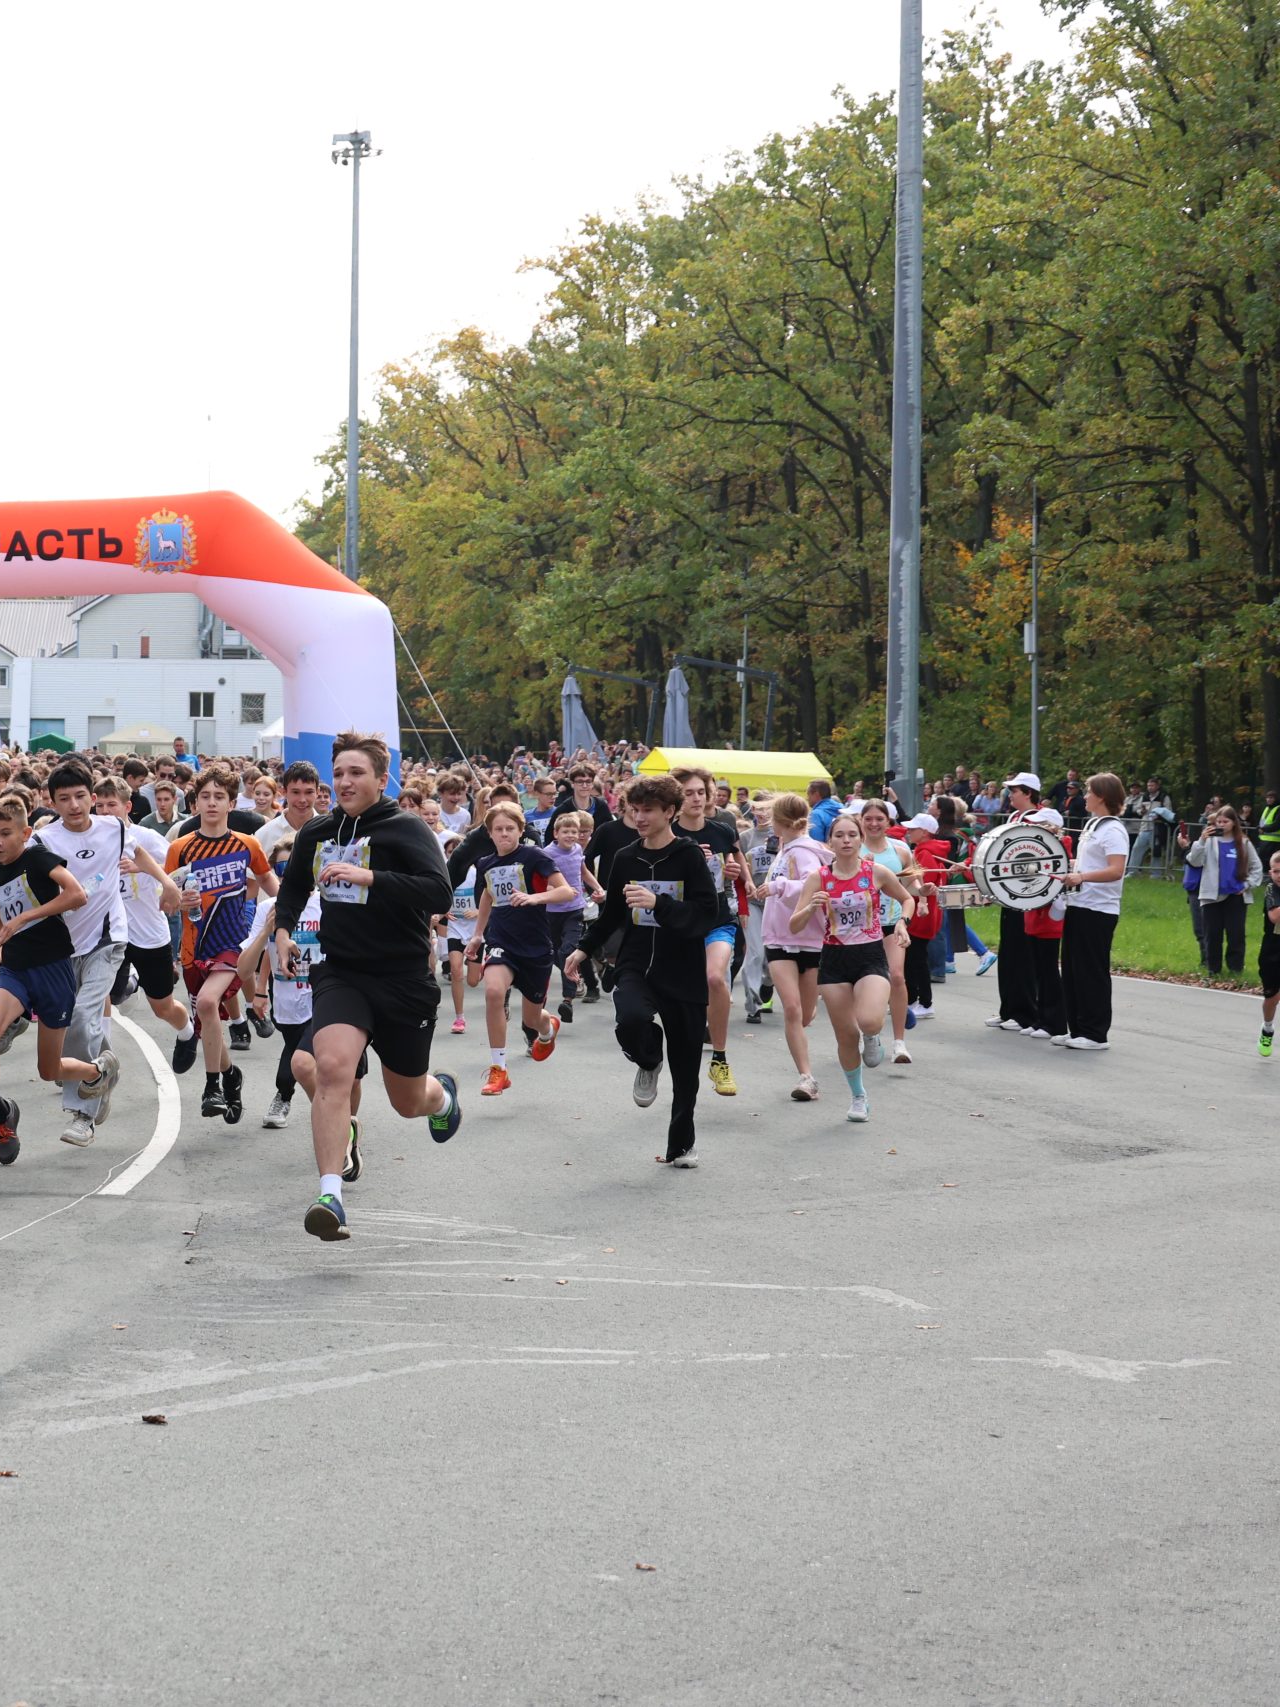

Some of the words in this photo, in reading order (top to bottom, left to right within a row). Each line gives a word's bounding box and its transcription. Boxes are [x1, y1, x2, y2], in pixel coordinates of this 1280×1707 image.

[1005, 844, 1046, 861] БАРАБАННЫЙ
[755, 856, 771, 867] 788
[1013, 863, 1038, 875] БУ
[194, 859, 246, 880] GREEN
[494, 881, 514, 897] 789
[839, 910, 862, 925] 830
